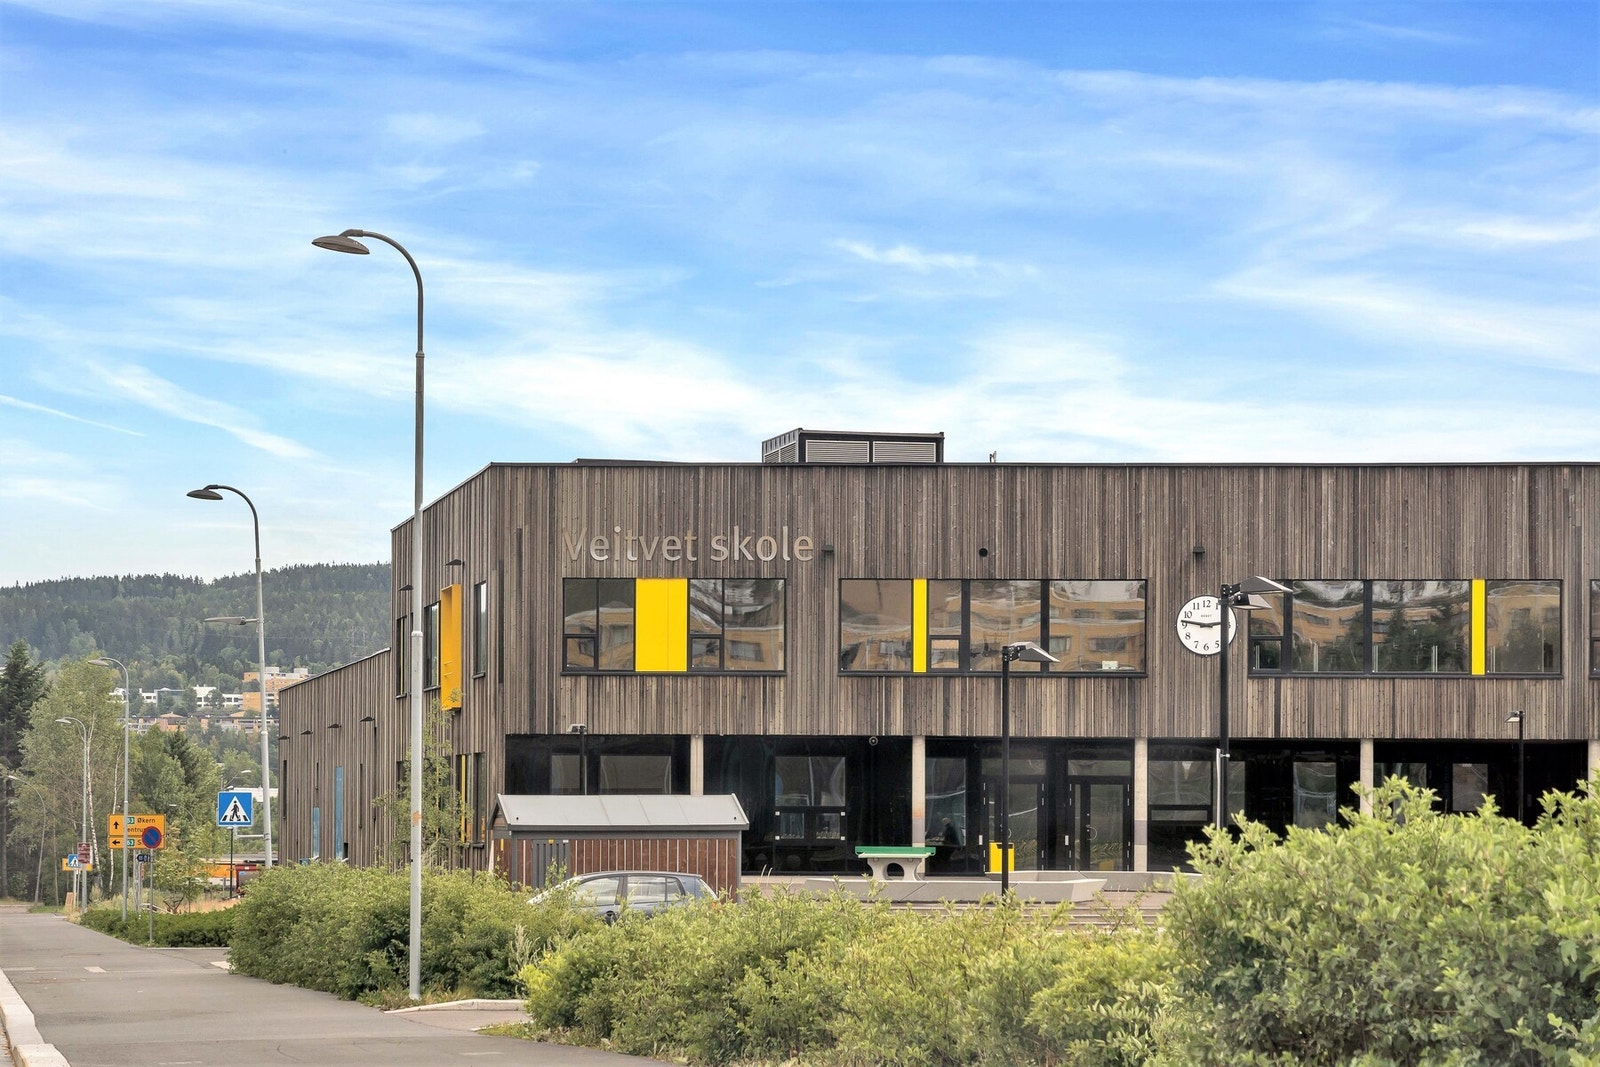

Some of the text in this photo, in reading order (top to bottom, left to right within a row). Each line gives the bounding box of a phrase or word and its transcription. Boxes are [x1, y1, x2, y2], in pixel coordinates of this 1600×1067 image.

[562, 525, 814, 561] Veitvet skole
[1193, 602, 1200, 610] 11
[1203, 600, 1211, 608] 12
[1185, 632, 1190, 640] 8
[1203, 643, 1209, 651] 6
[1215, 640, 1219, 648] 5
